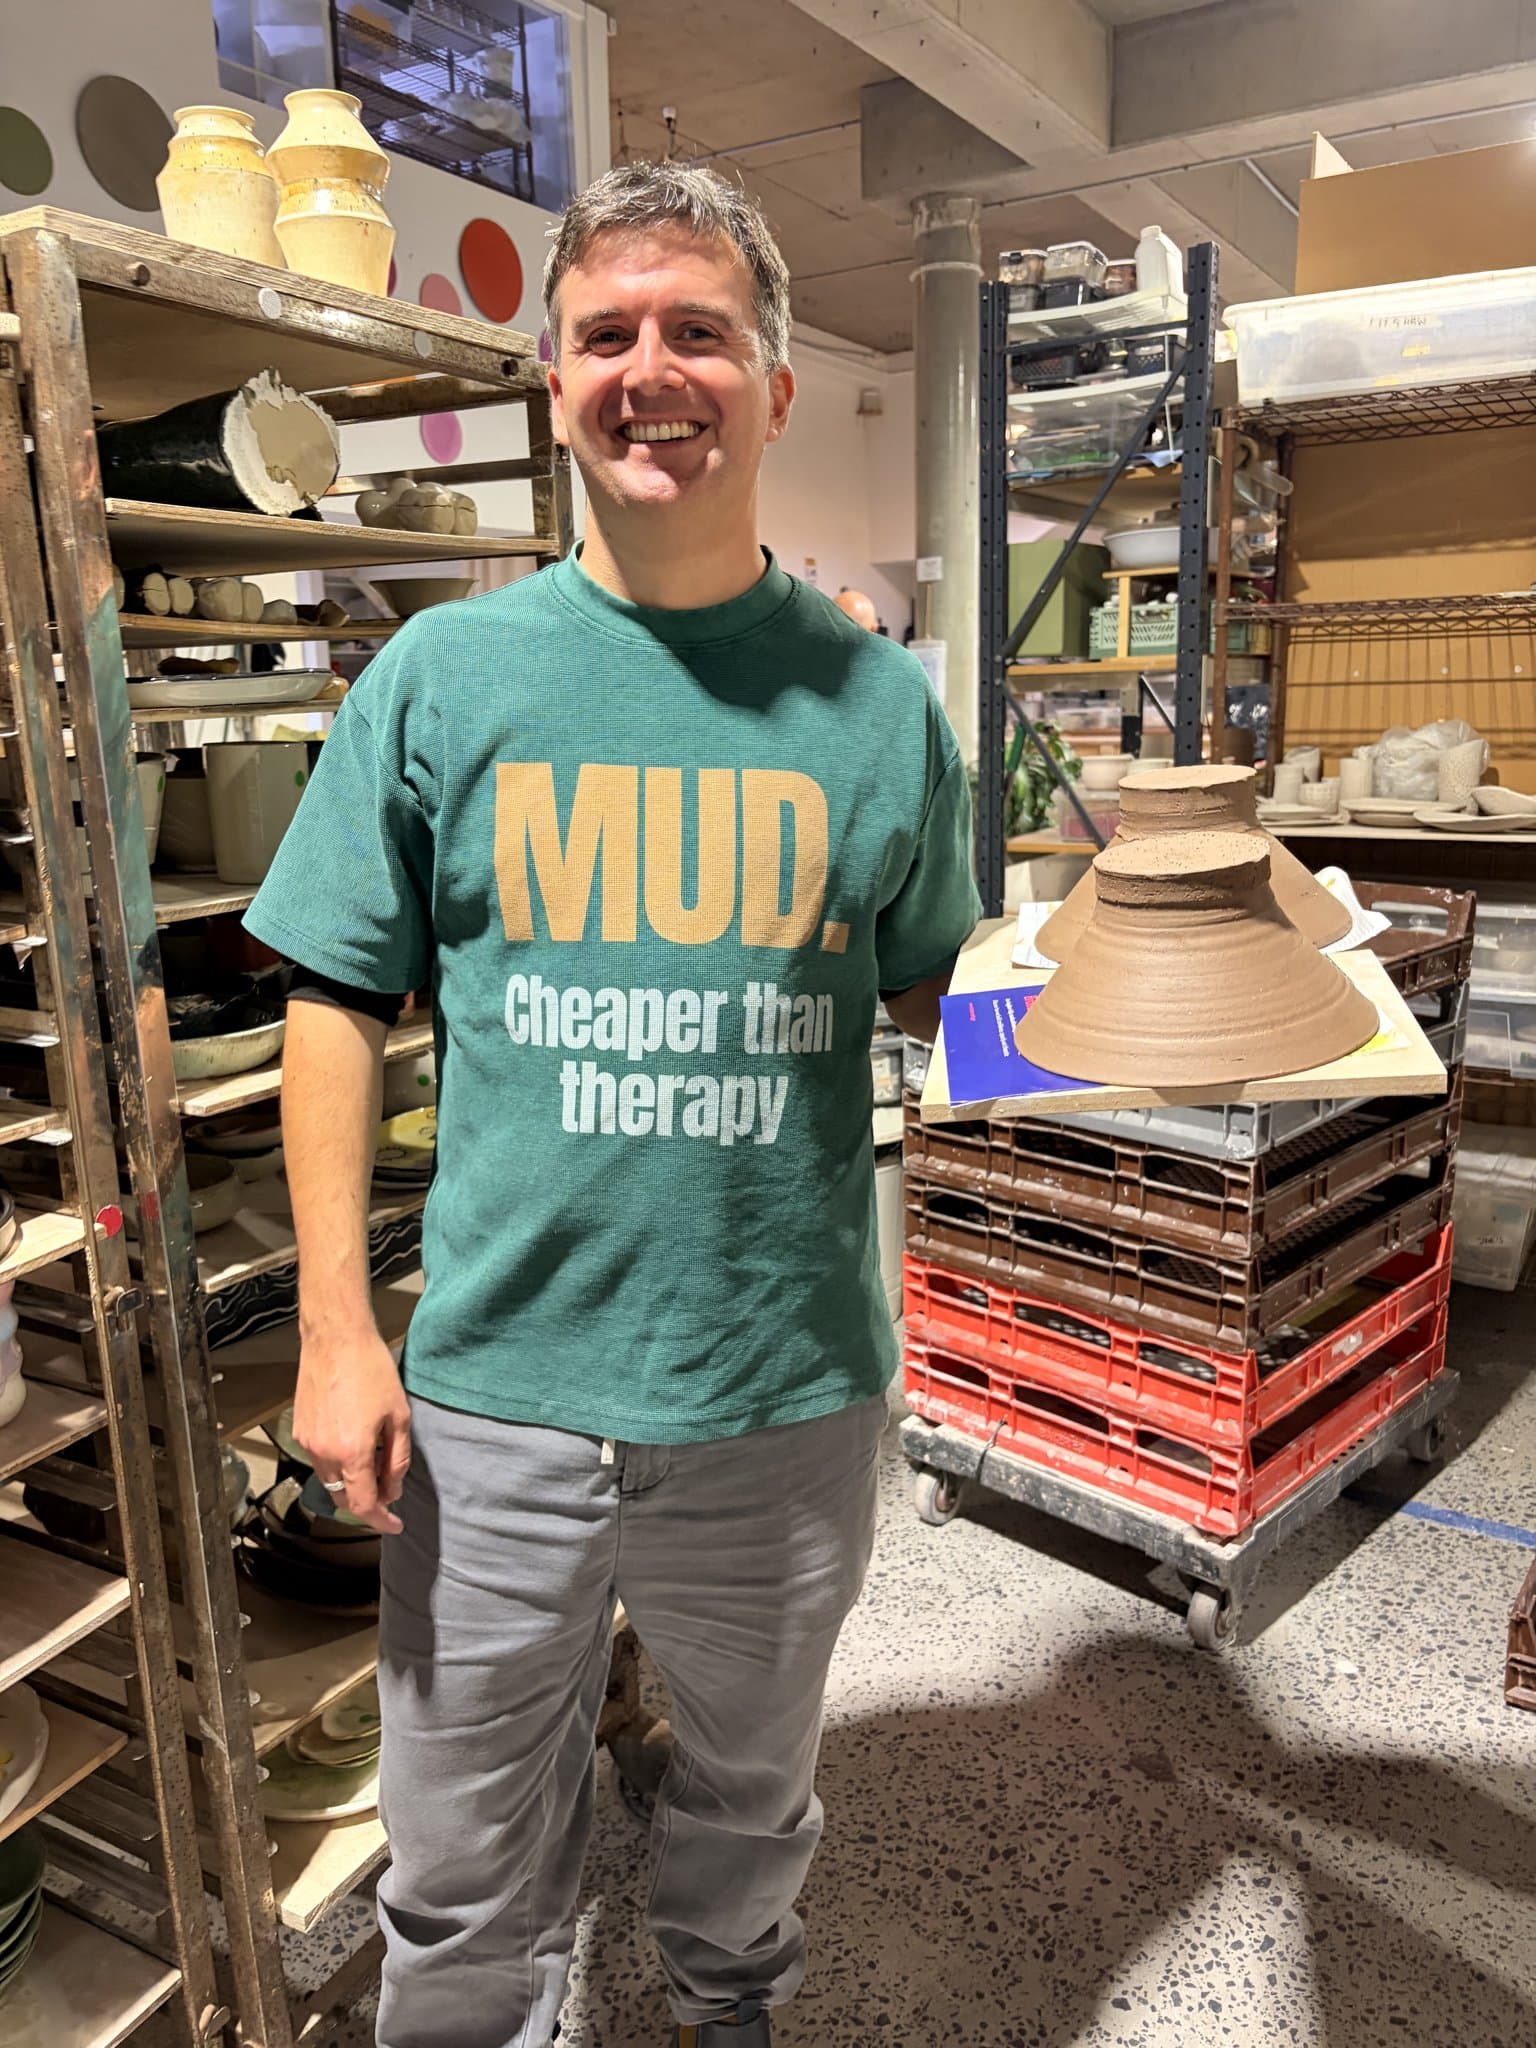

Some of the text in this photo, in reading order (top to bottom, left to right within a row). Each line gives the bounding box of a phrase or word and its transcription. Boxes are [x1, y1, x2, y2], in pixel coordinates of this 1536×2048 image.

[494, 762, 850, 954] MUD.
[504, 974, 833, 1061] Cheaper than
[559, 1060, 789, 1146] therapy
